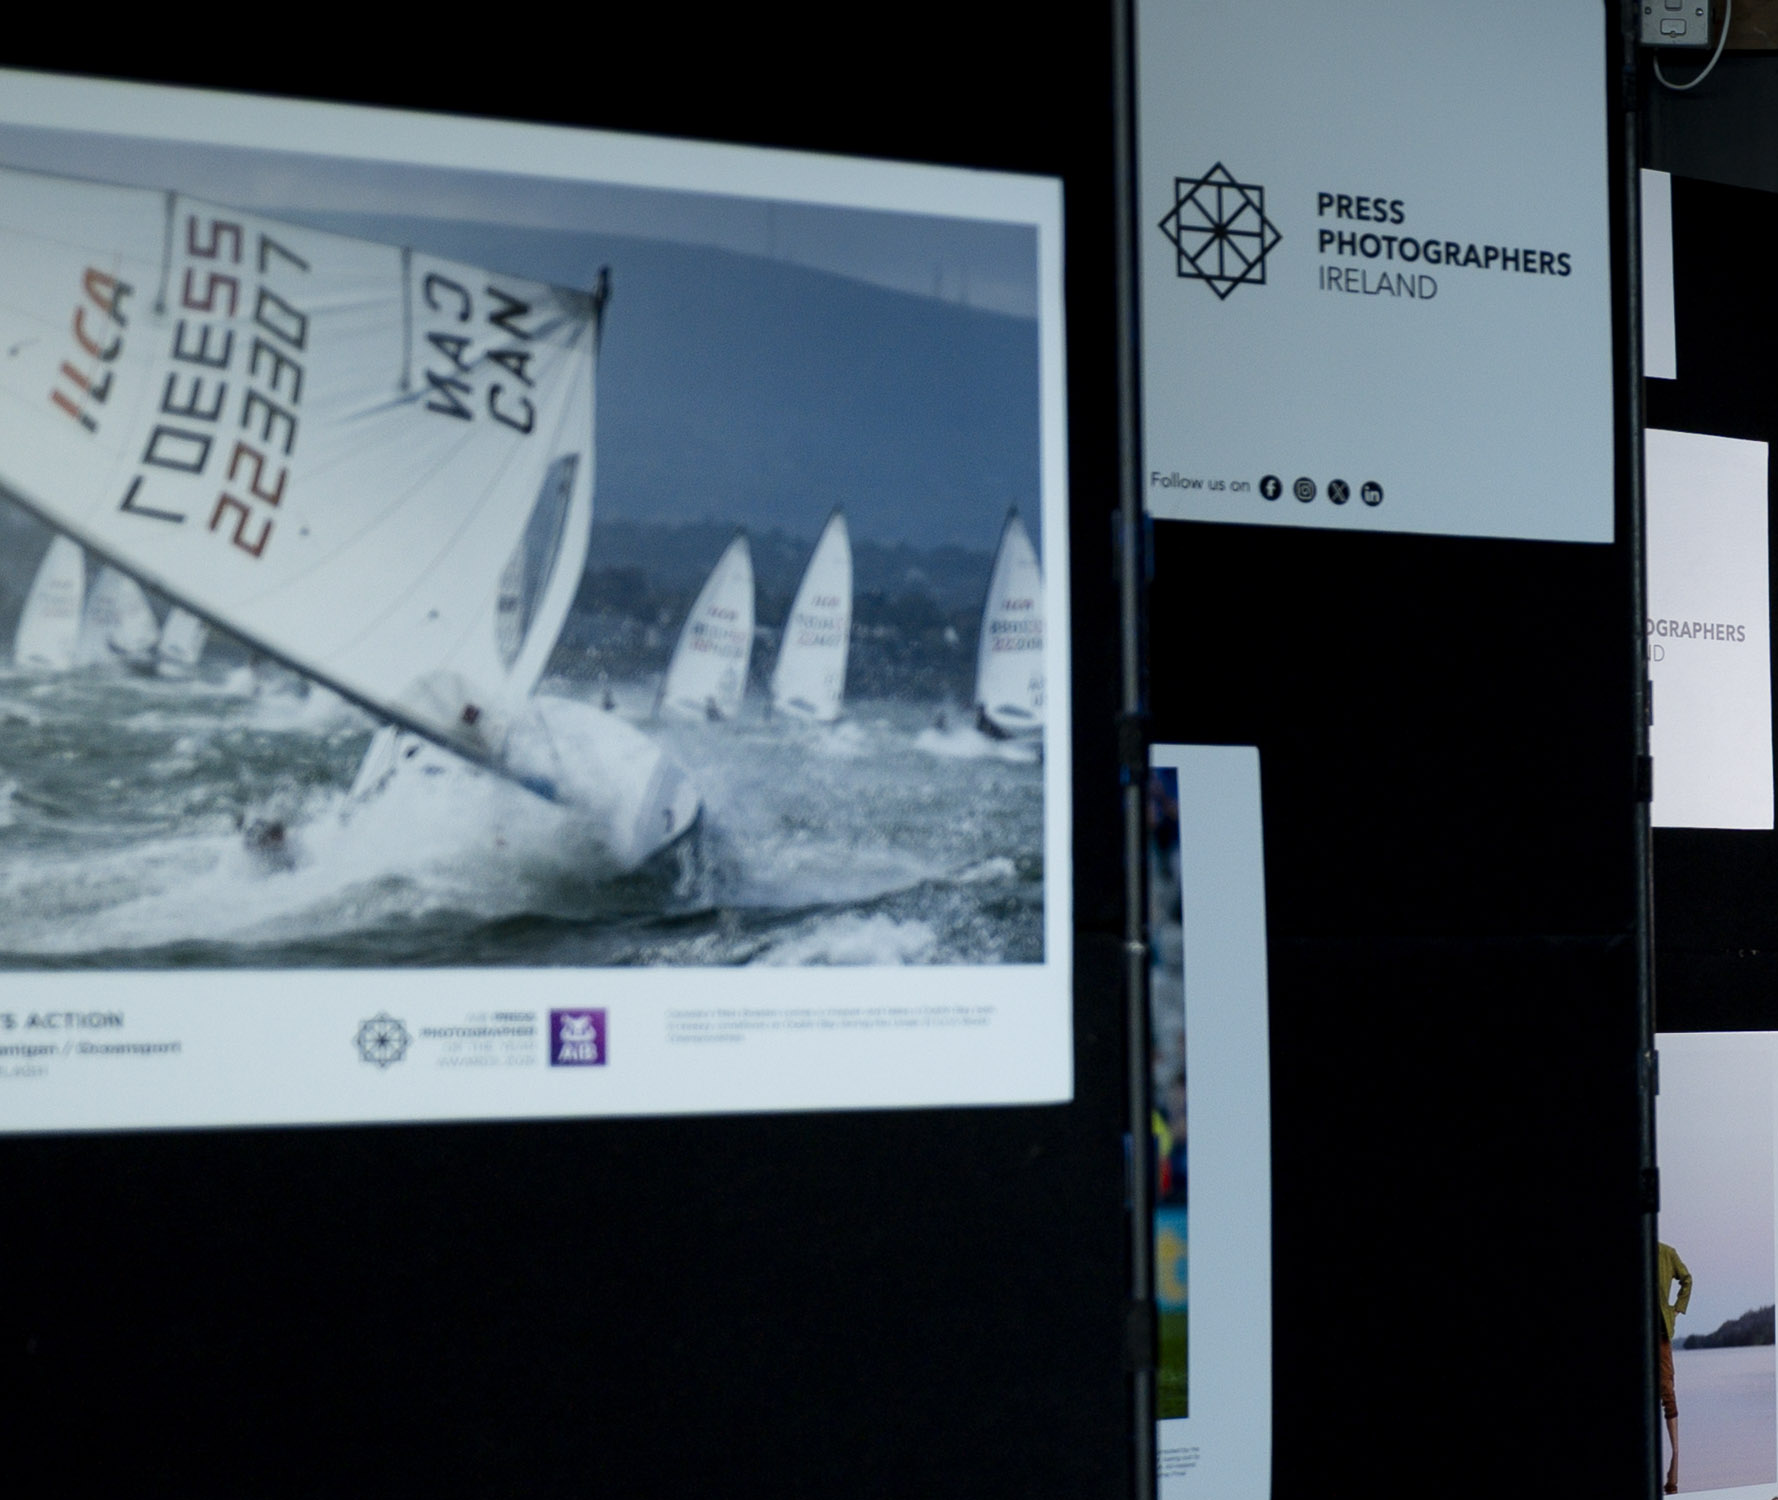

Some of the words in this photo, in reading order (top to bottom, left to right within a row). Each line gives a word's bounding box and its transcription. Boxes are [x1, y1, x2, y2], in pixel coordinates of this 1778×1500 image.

[1317, 192, 1406, 225] PRESS
[1318, 228, 1572, 277] PHOTOGRAPHERS
[1319, 266, 1438, 300] IRELAND
[52, 267, 134, 434] ILCA
[485, 285, 535, 434] CAN
[1150, 471, 1203, 490] Follow
[1209, 480, 1226, 491] us
[1229, 481, 1251, 492] on
[25, 1010, 125, 1030] ACTION
